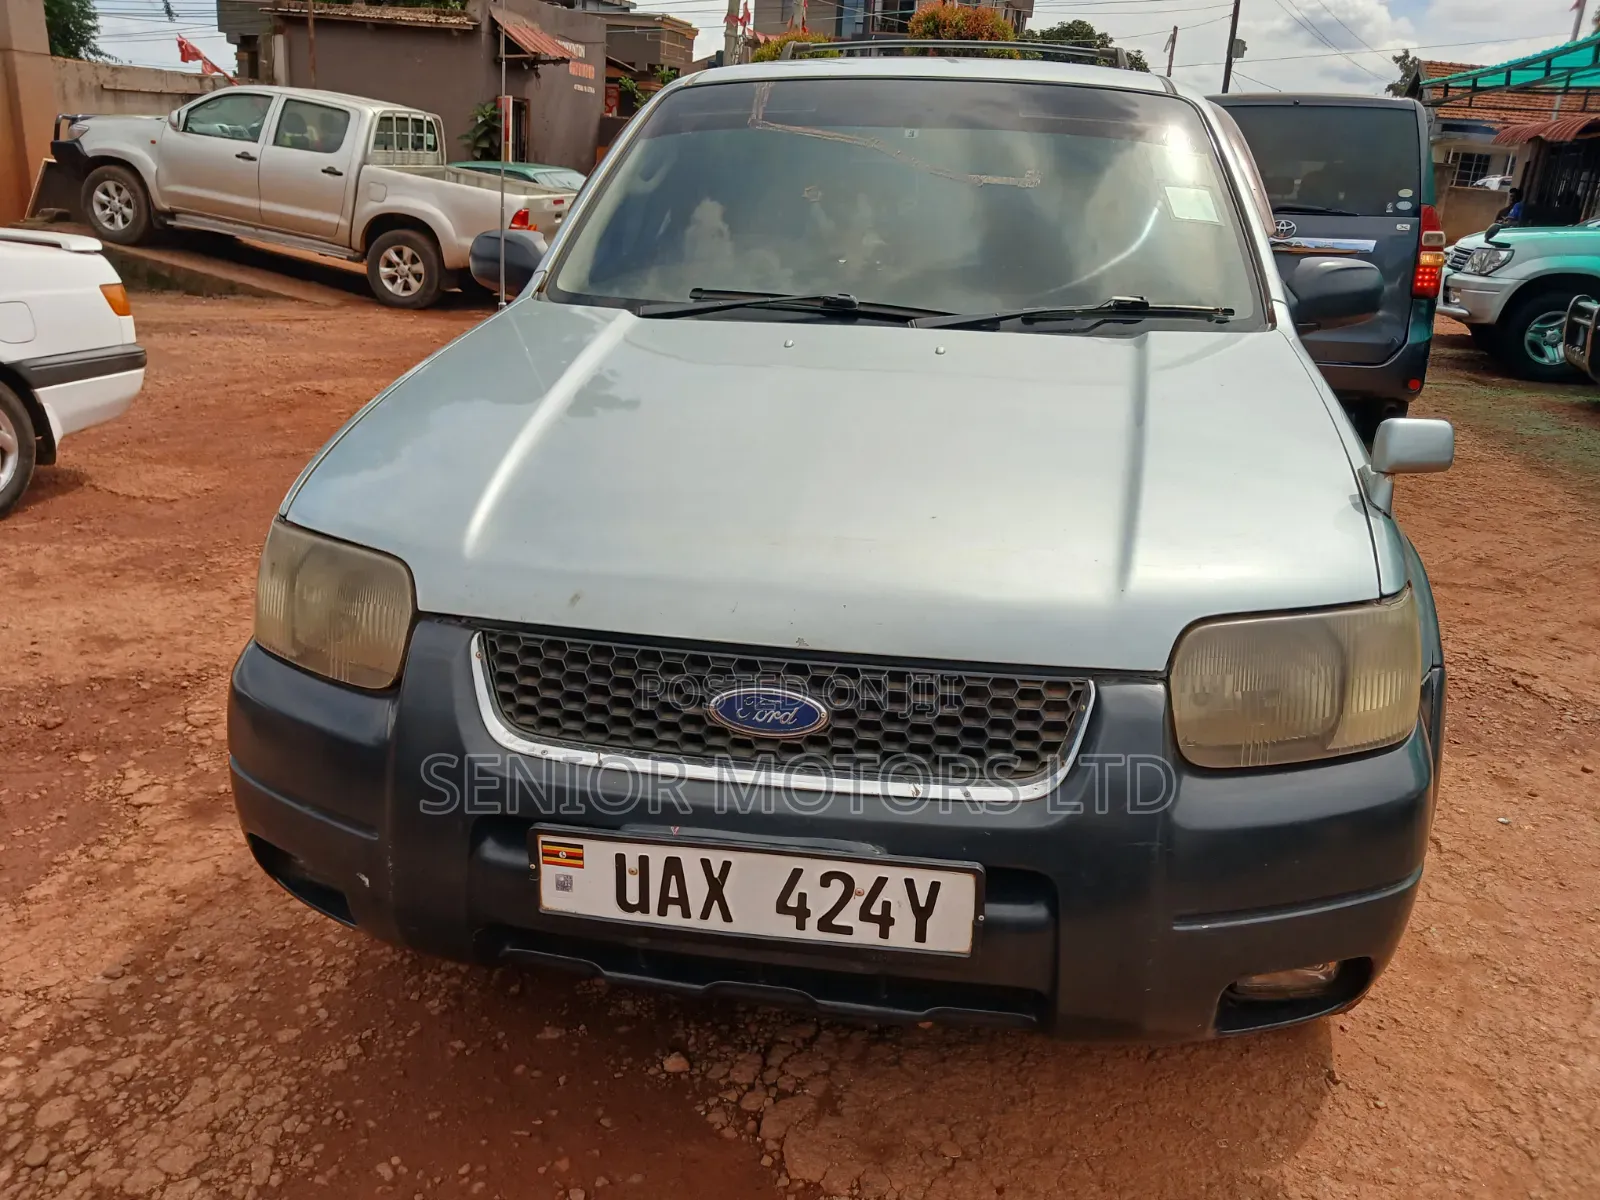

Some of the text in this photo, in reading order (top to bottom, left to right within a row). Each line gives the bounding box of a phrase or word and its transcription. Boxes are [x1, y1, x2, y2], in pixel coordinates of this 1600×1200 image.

[736, 696, 799, 726] Ford
[614, 851, 942, 943] UAX 424Y
